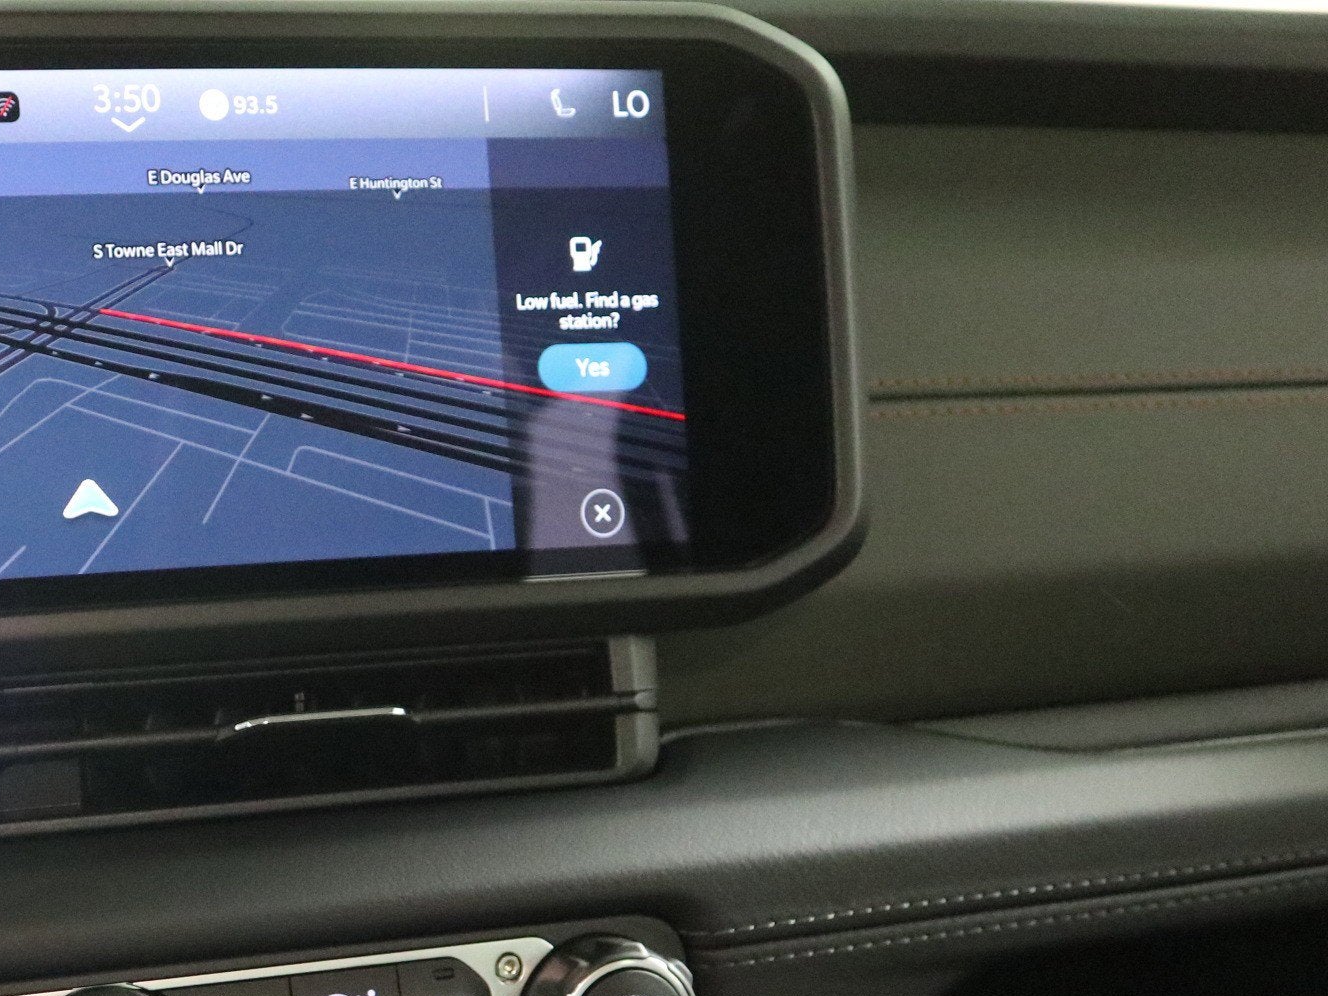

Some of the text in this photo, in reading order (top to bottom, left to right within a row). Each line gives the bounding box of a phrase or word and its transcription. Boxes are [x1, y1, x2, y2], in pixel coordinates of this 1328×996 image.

[93, 83, 161, 113] 3:50
[234, 95, 278, 116] 93.5
[612, 90, 650, 118] LO
[148, 168, 251, 188] E Douglas Ave
[350, 176, 442, 192] E Huntington St
[93, 241, 243, 259] S Towne East Mall Dr
[516, 292, 659, 311] Low fuel. Find a gas
[559, 313, 620, 330] station?
[575, 358, 611, 378] Yes
